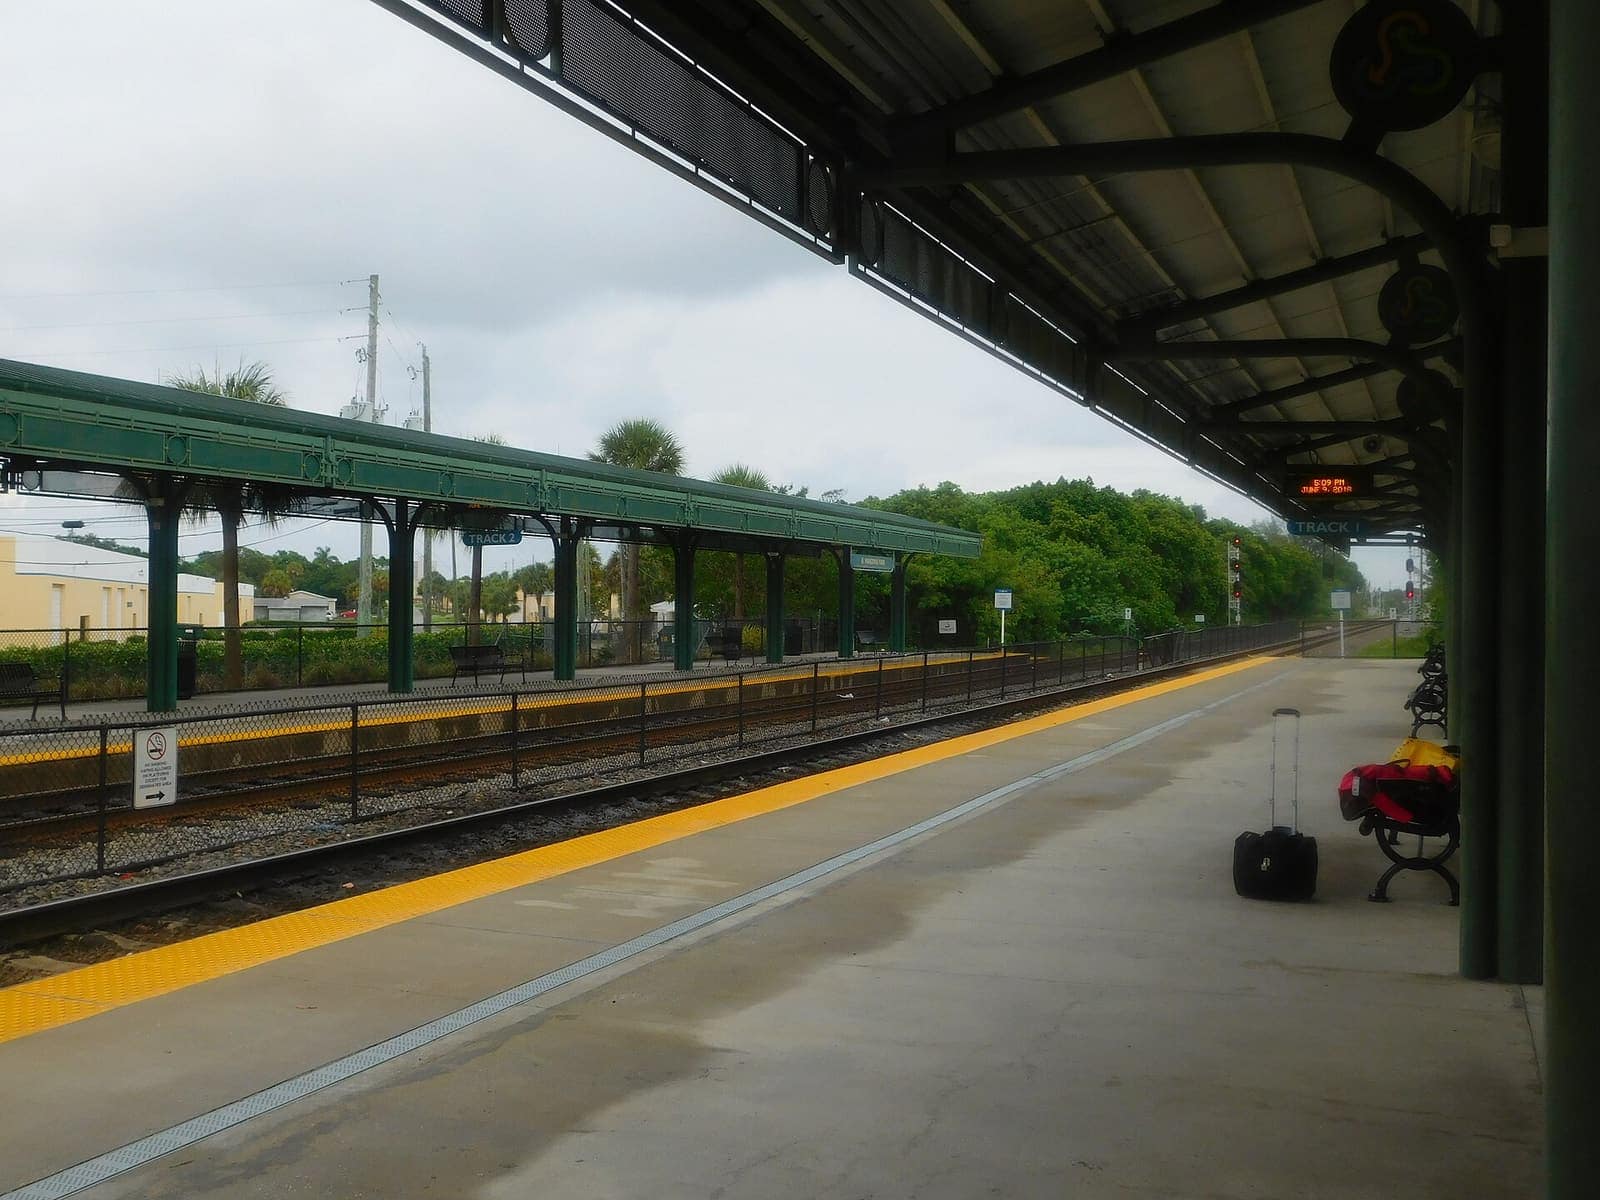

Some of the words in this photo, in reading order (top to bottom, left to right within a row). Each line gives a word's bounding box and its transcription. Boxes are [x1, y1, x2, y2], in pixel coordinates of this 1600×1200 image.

[1313, 479, 1332, 487] 5:09
[1334, 478, 1345, 486] PM
[1295, 521, 1349, 533] TRACK
[469, 533, 506, 544] TRACK
[508, 532, 516, 543] 2
